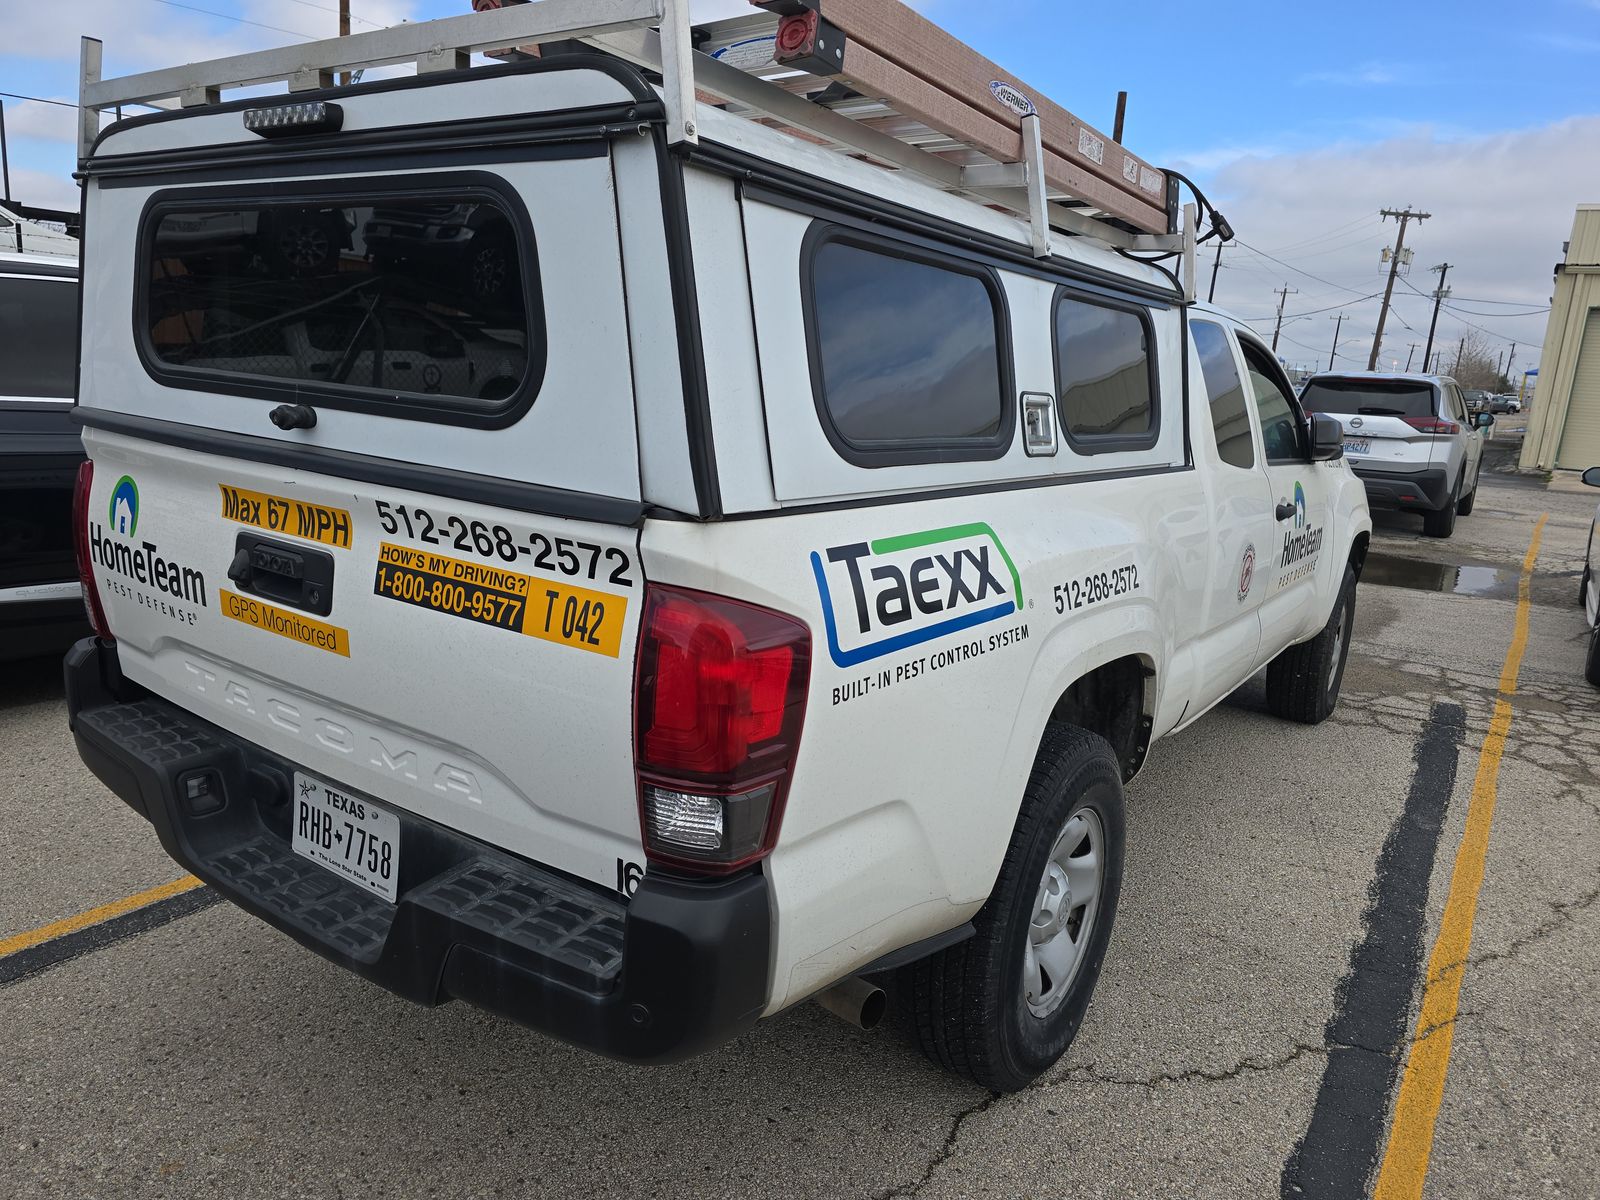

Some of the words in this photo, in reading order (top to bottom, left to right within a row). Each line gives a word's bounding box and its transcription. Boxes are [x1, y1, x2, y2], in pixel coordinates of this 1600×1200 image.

[1000, 87, 1029, 113] WERNER
[222, 487, 262, 526] Max
[267, 497, 290, 531] 67
[297, 503, 349, 547] MPH
[375, 499, 633, 588] 512-268-2572
[90, 521, 208, 608] HomeTeam
[380, 545, 425, 569] HOW'S
[428, 556, 451, 574] MY
[454, 563, 527, 593] DRIVING?
[1280, 523, 1323, 568] HomeTeam
[106, 578, 132, 600] PEST
[378, 566, 523, 627] 1-800-800-9577
[1053, 563, 1140, 615] 512-268-2572
[1278, 571, 1292, 589] PEST
[229, 595, 258, 623] GPS
[262, 606, 337, 651] Monitored
[544, 589, 559, 633] T
[561, 594, 605, 646] 042
[832, 669, 892, 706] BUILT-IN
[896, 658, 926, 683] PEST
[930, 640, 986, 670] CONTROL
[989, 624, 1030, 652] SYSTEM
[184, 659, 483, 804] TACOMA
[324, 788, 365, 821] TEXAS
[319, 852, 328, 861] The
[329, 857, 341, 868] Lone
[341, 864, 353, 874] Star
[353, 869, 367, 882] State
